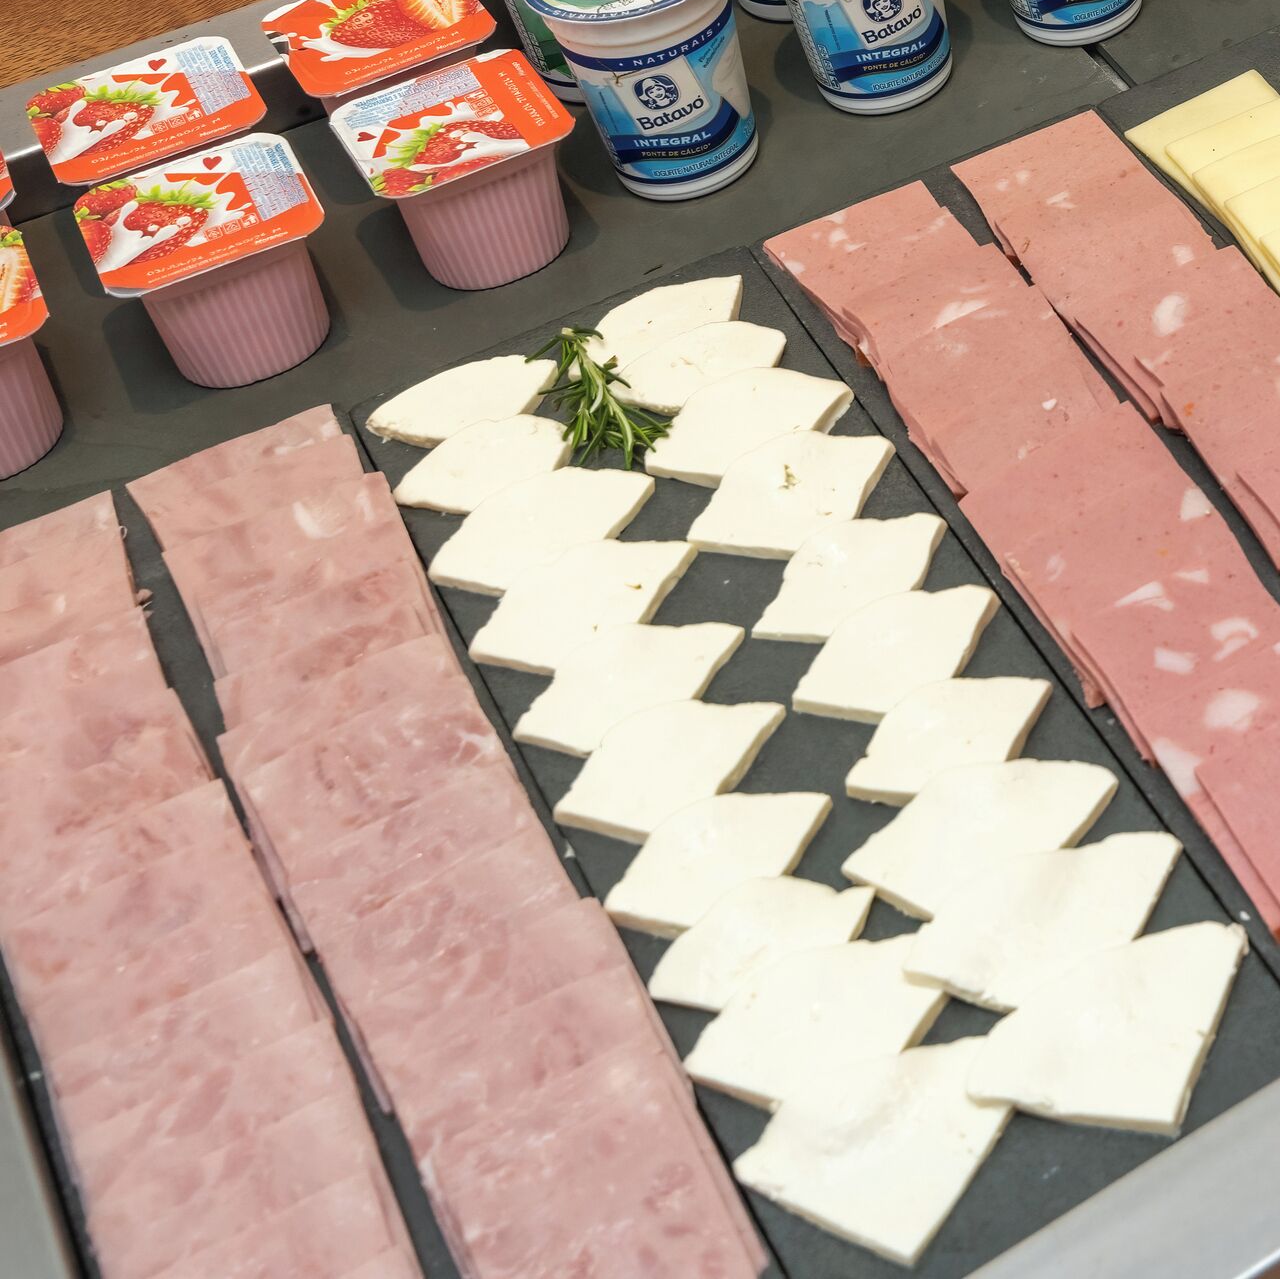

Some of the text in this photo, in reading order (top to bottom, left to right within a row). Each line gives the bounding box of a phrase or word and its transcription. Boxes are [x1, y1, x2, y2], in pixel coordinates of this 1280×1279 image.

[861, 7, 922, 45] Batavo
[632, 28, 714, 67] NATURAIS
[855, 40, 926, 63] INTEGRAL
[636, 97, 704, 132] Batavo
[633, 130, 712, 148] INTEGRAL
